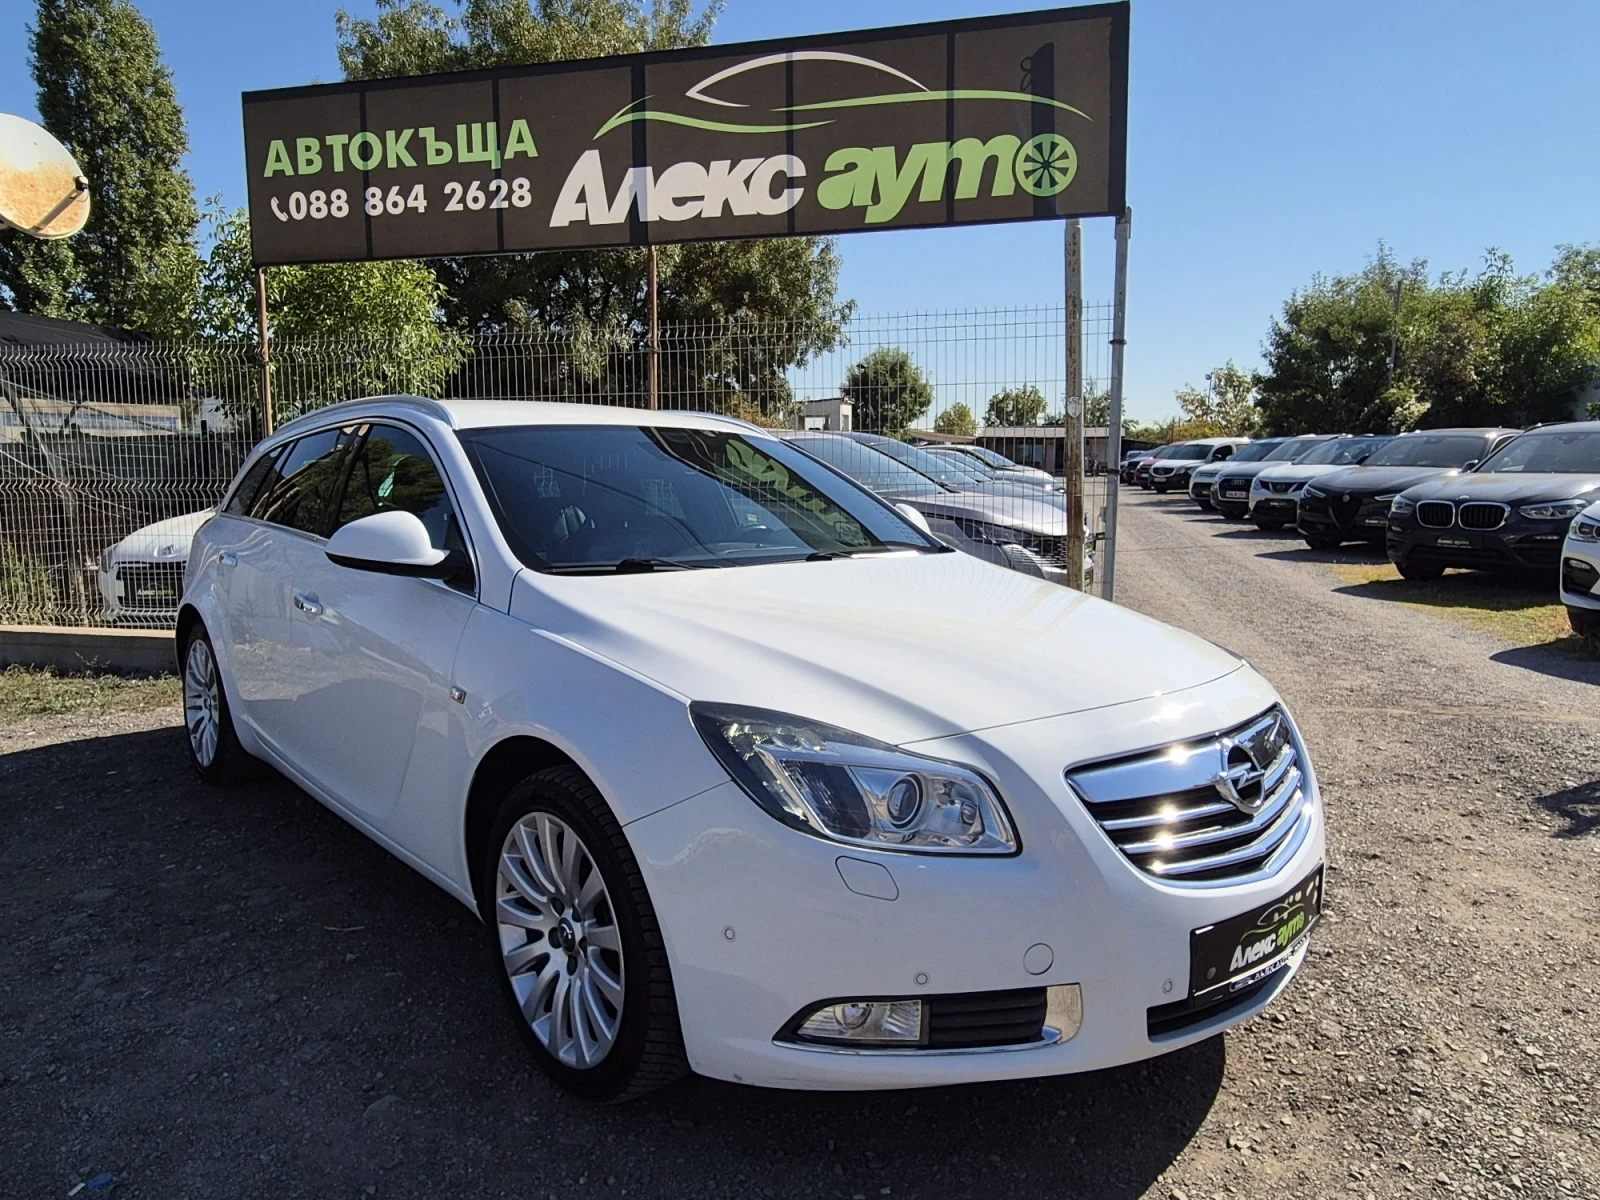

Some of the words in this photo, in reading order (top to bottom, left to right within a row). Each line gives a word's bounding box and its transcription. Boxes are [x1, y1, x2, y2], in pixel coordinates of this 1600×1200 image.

[263, 118, 539, 178] АВТОКЪЩА
[288, 188, 350, 222] 088
[364, 183, 428, 217] 864
[443, 176, 533, 213] 2628
[549, 149, 807, 228] Алекс
[816, 132, 1078, 224] ауто
[1229, 933, 1276, 972] Алекс
